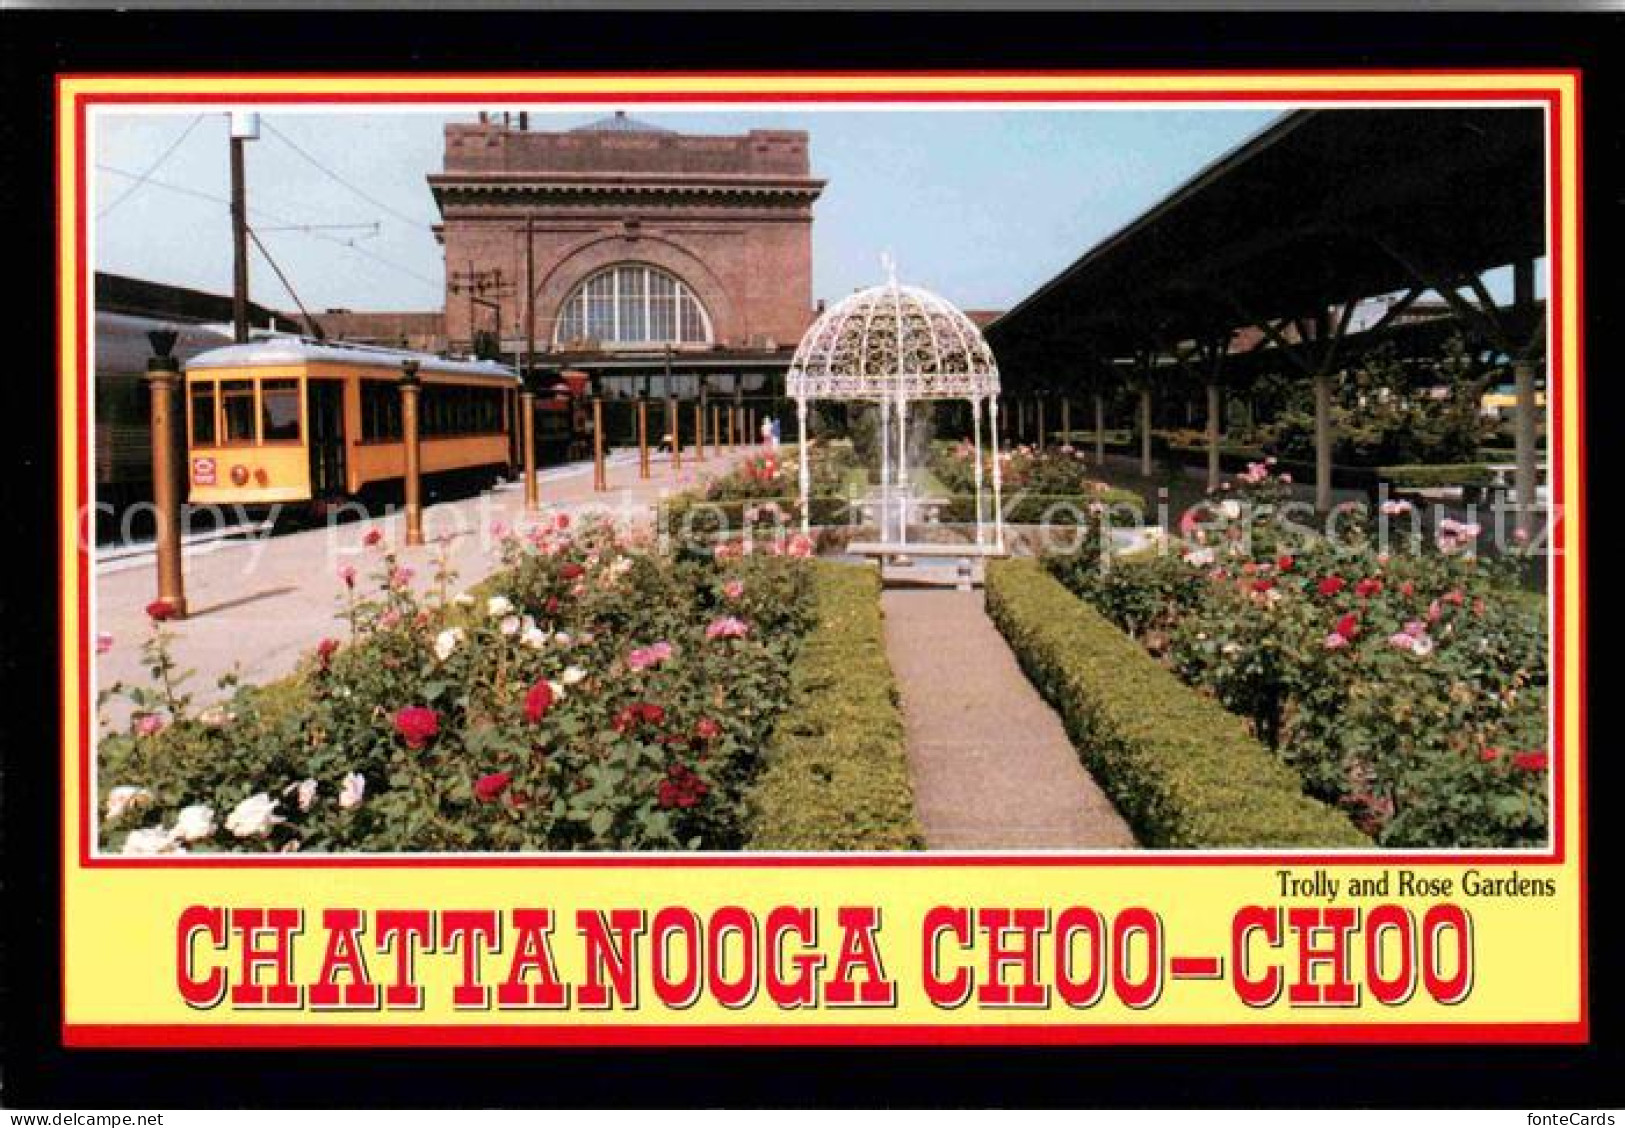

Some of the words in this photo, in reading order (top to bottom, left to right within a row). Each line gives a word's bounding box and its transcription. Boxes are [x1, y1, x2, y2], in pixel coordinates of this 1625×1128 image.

[1277, 870, 1339, 903] Trolly
[1348, 870, 1388, 897] and
[1399, 870, 1453, 897] Rose
[1462, 869, 1556, 897] Gardens
[176, 904, 898, 1011] CHATTANOOGA
[922, 902, 1475, 1010] CHOO-CHOO
